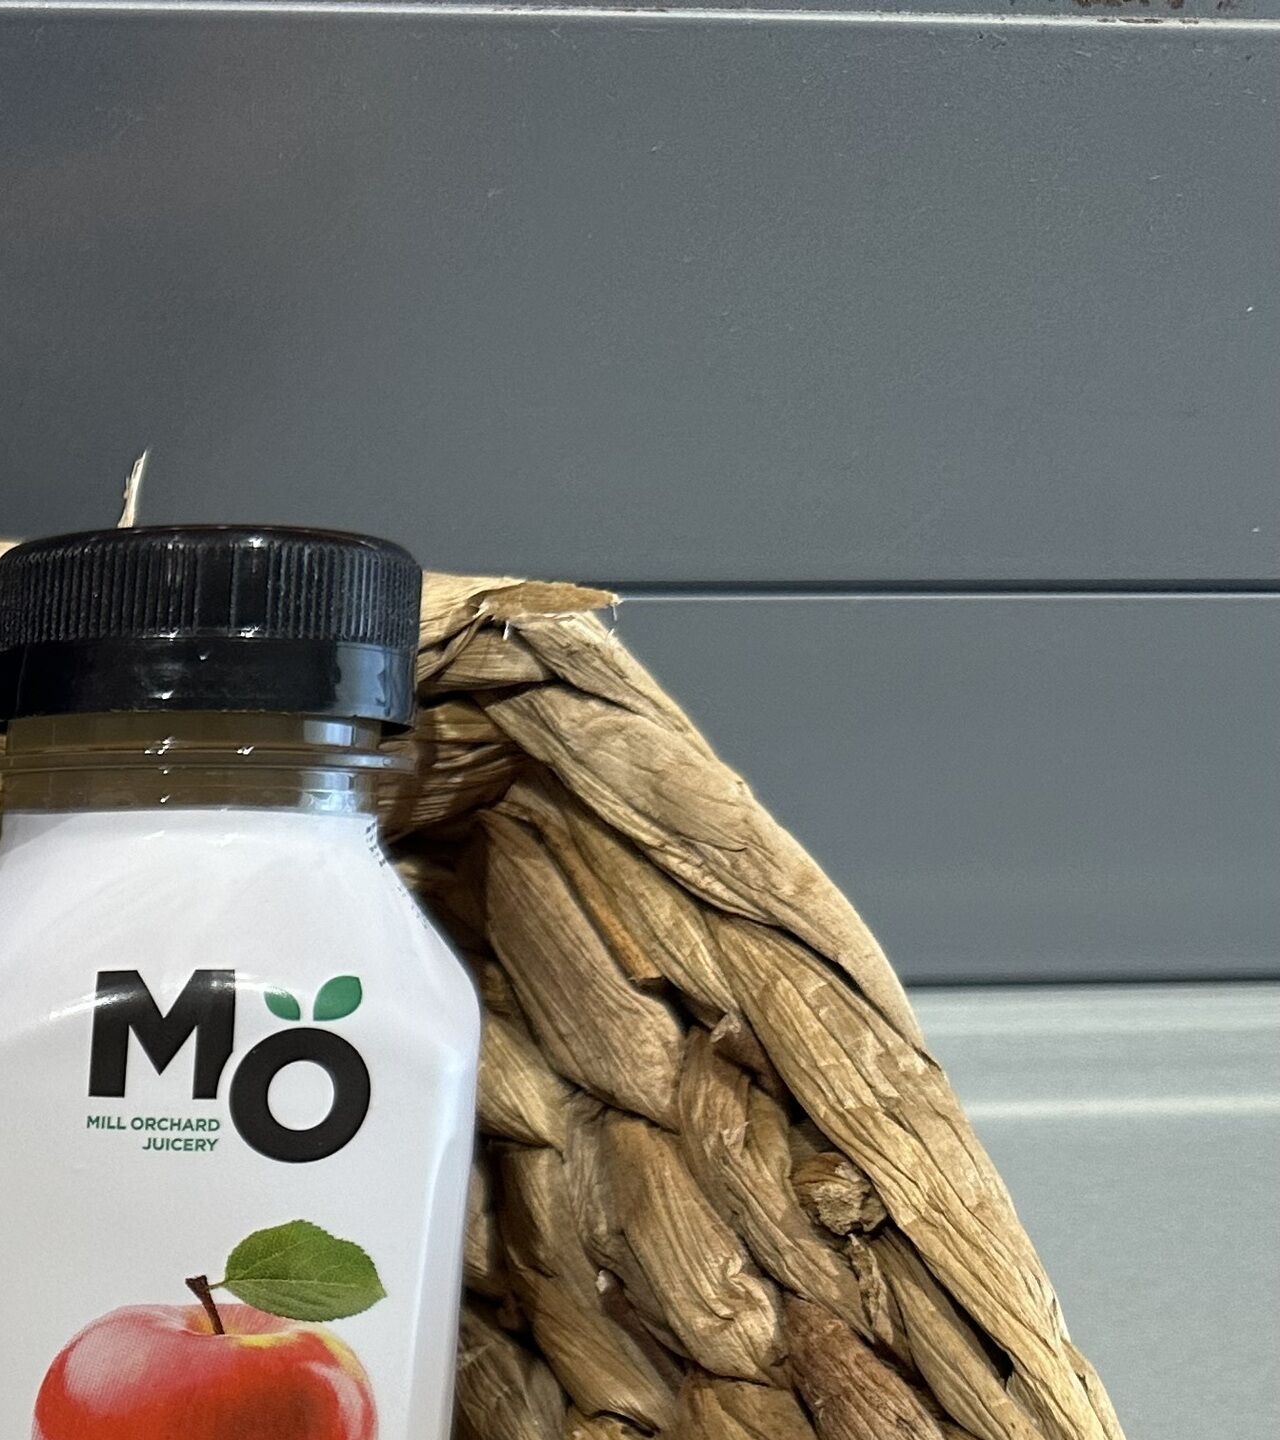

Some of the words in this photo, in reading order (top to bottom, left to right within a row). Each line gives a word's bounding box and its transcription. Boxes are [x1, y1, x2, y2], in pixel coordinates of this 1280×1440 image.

[86, 1116, 126, 1130] MILL
[130, 1117, 221, 1132] ORCHARD
[142, 1138, 219, 1152] JUICERY
